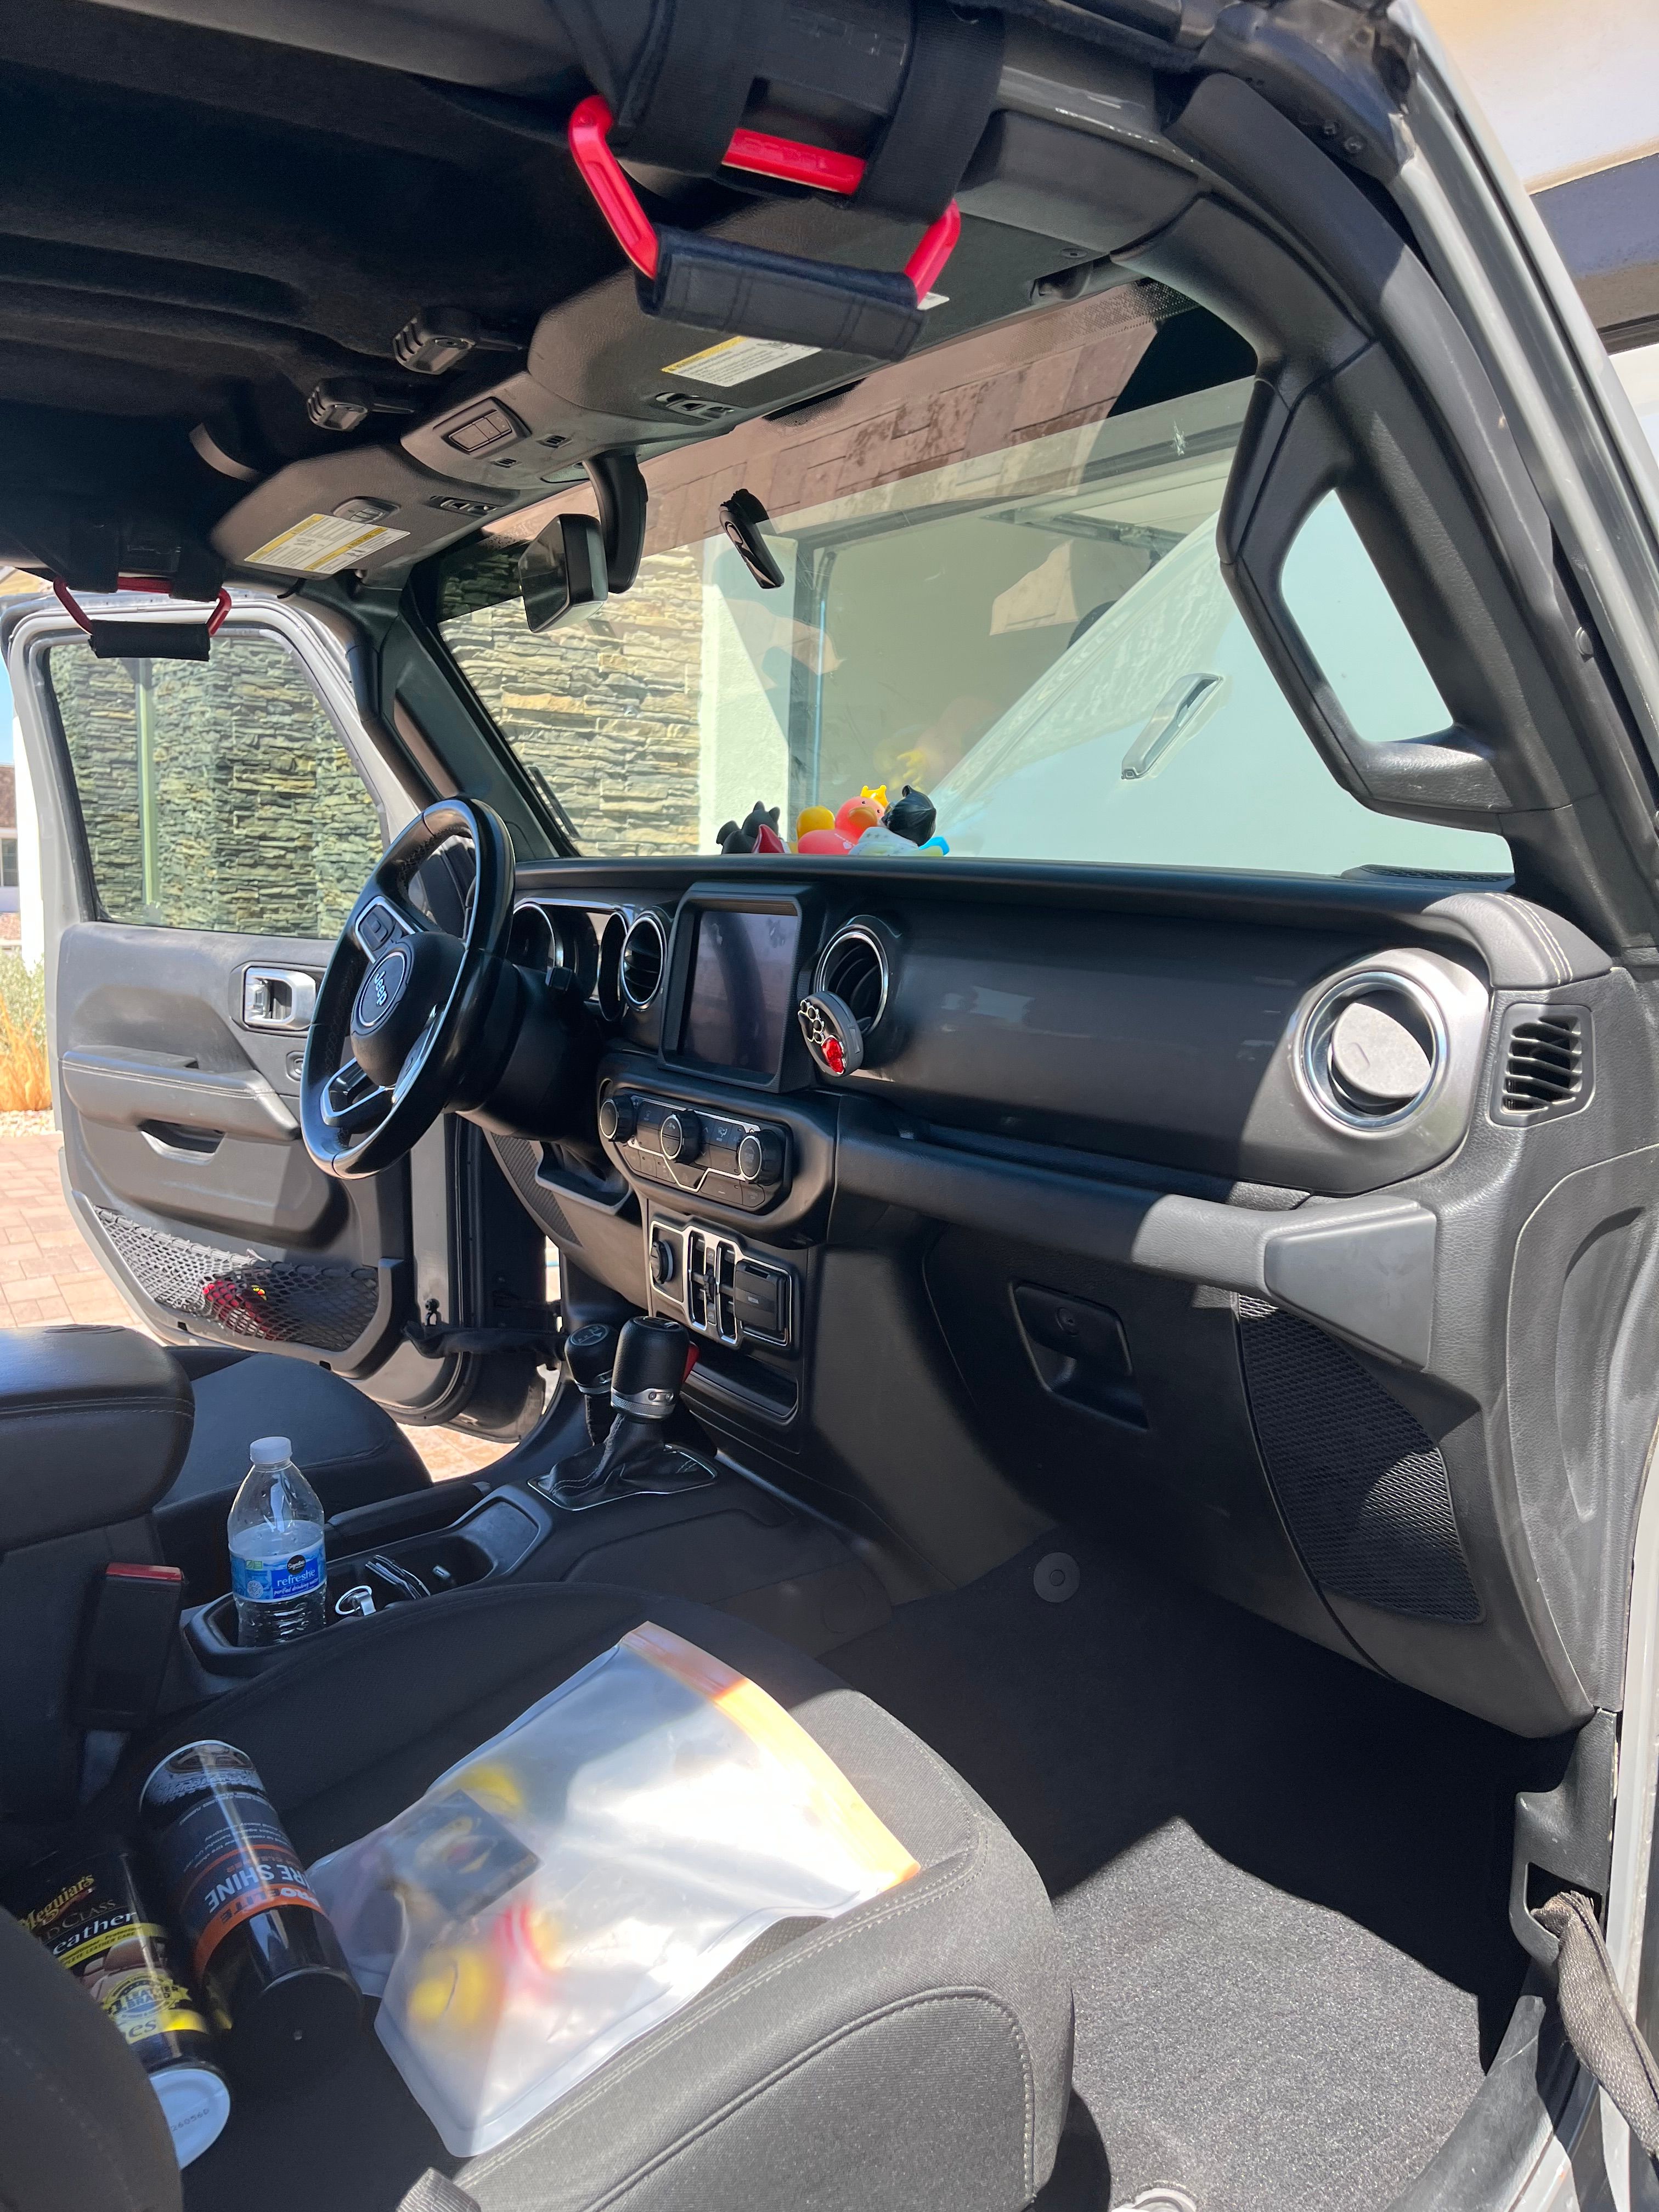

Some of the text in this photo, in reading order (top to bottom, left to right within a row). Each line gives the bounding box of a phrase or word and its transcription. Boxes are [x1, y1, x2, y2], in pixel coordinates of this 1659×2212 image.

[374, 970, 387, 1006] Jeep
[277, 1570, 315, 1587] refreshe
[205, 1864, 274, 1914] SHINE
[276, 1864, 311, 1891] IRE
[53, 1911, 137, 1955] eather
